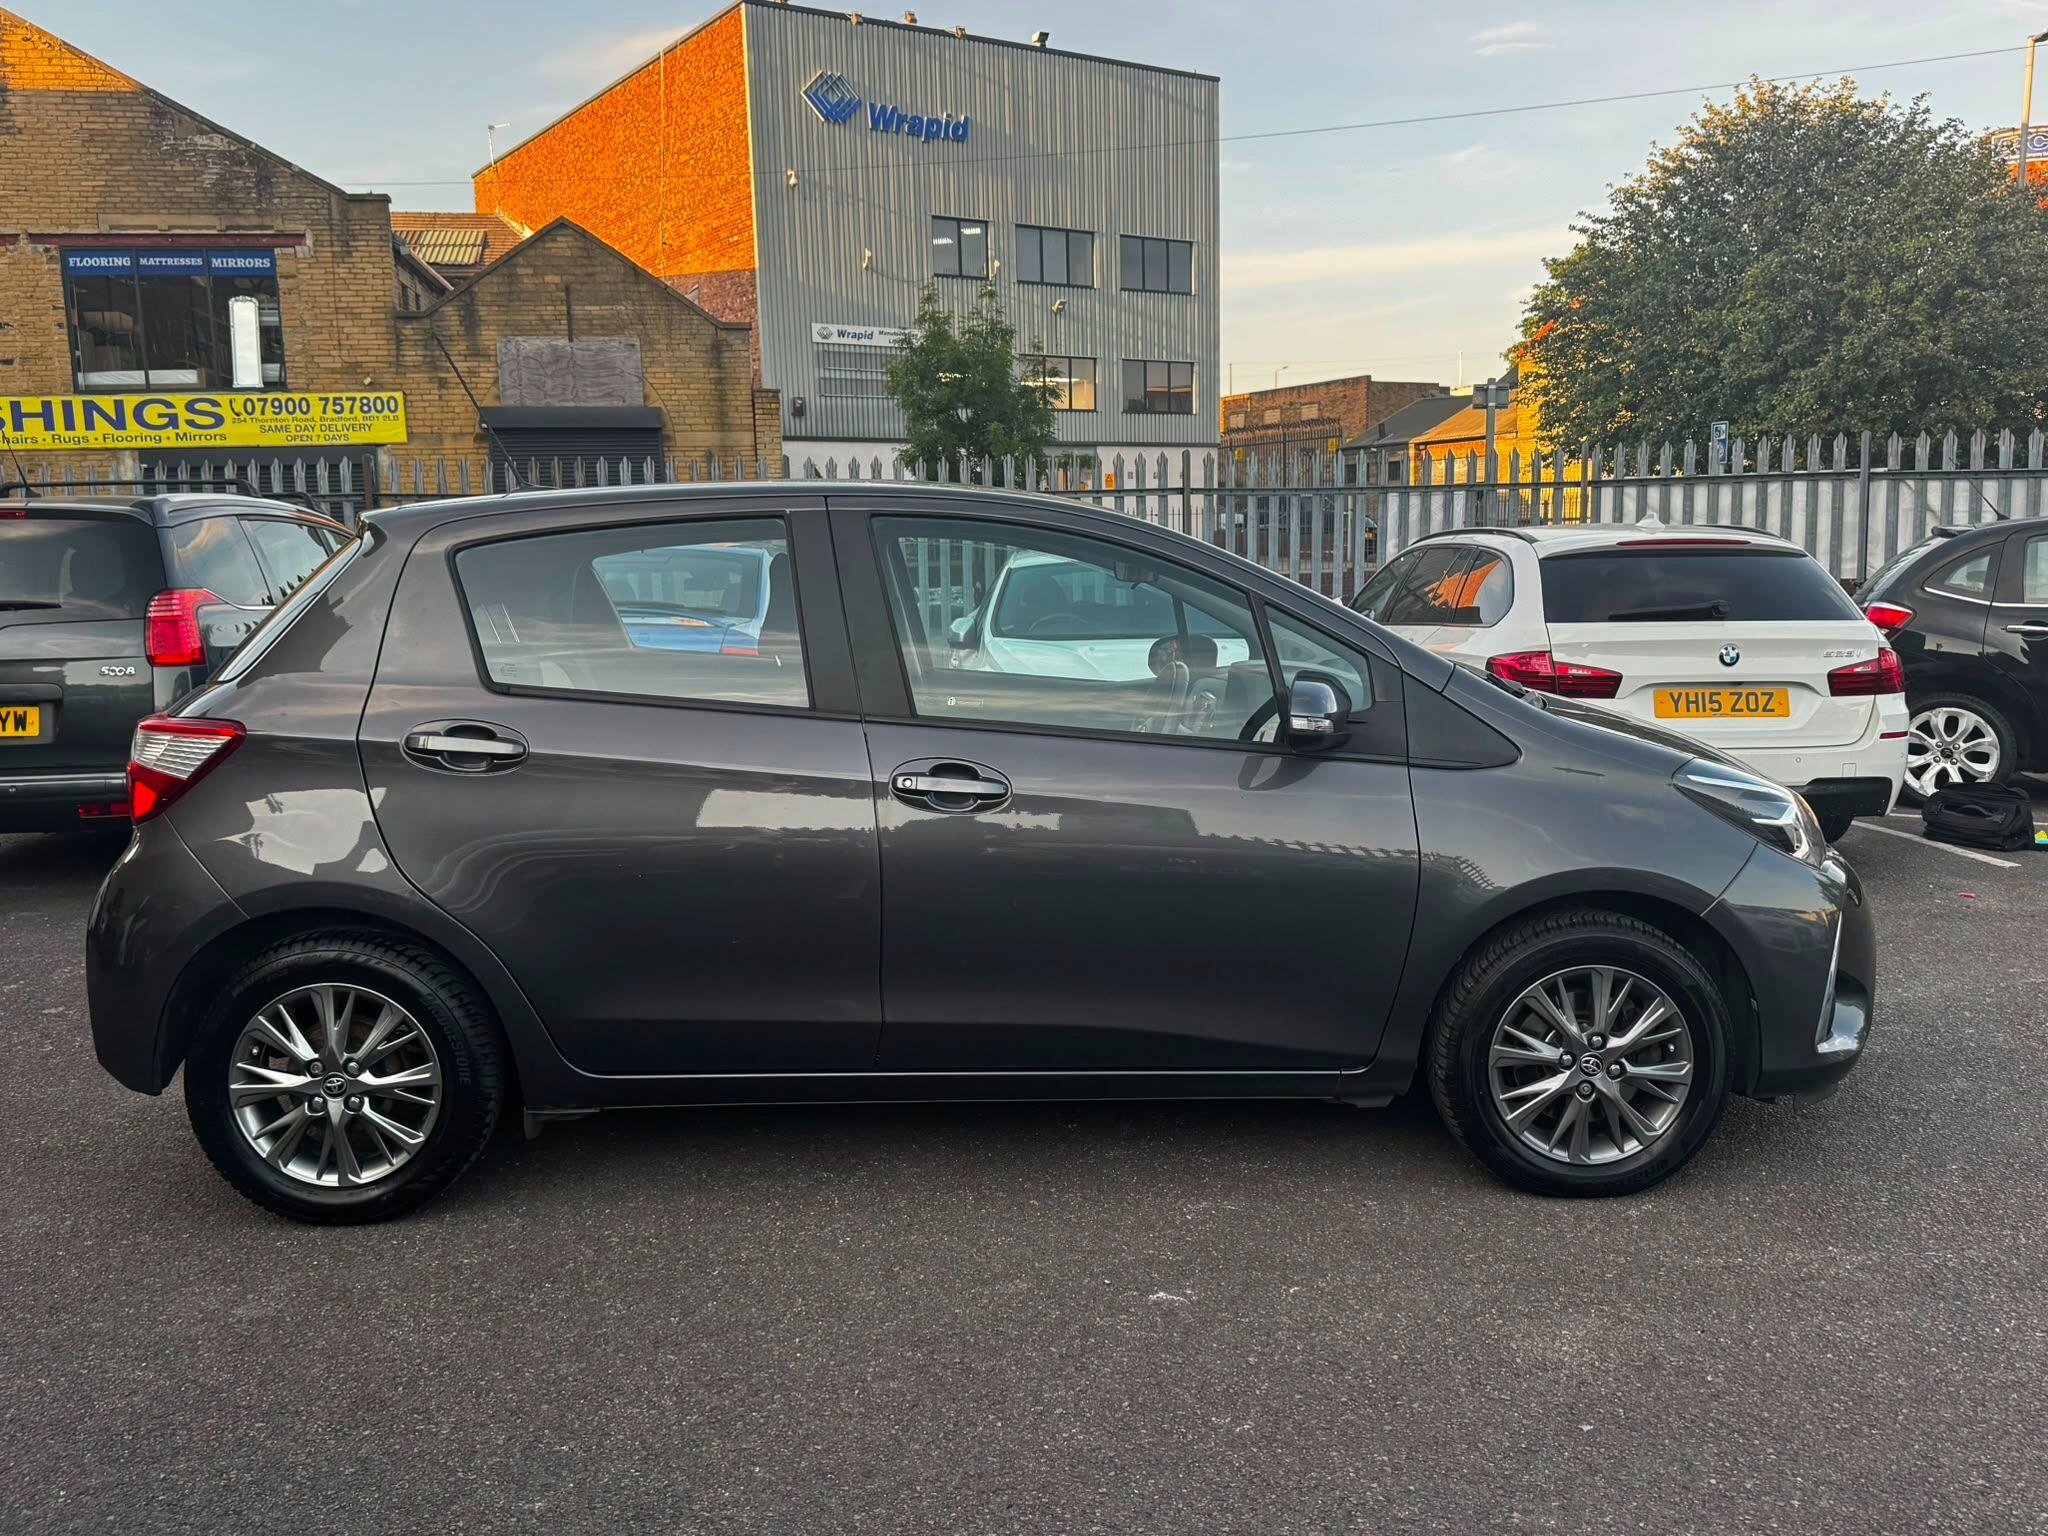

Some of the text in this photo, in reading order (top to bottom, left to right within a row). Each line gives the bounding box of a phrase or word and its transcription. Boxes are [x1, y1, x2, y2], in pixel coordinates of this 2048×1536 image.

[867, 101, 969, 144] Wrapid
[69, 257, 131, 267] FLOORING
[139, 257, 203, 266] MATTRESSES
[211, 258, 271, 268] MIRRORS
[837, 329, 874, 341] Wrapid
[243, 396, 399, 416] 07900 757800
[0, 398, 225, 432] HINGS
[292, 416, 317, 424] Road,
[320, 416, 360, 424] Bradford,
[259, 423, 373, 434] SAME DAY DELIVERY
[0, 432, 227, 445] hairs Rugs Flooring Mirrors
[285, 433, 350, 443] OPEN 7 DAYS
[100, 666, 136, 676] 5008
[1669, 692, 1775, 713] YH15 ZOZ
